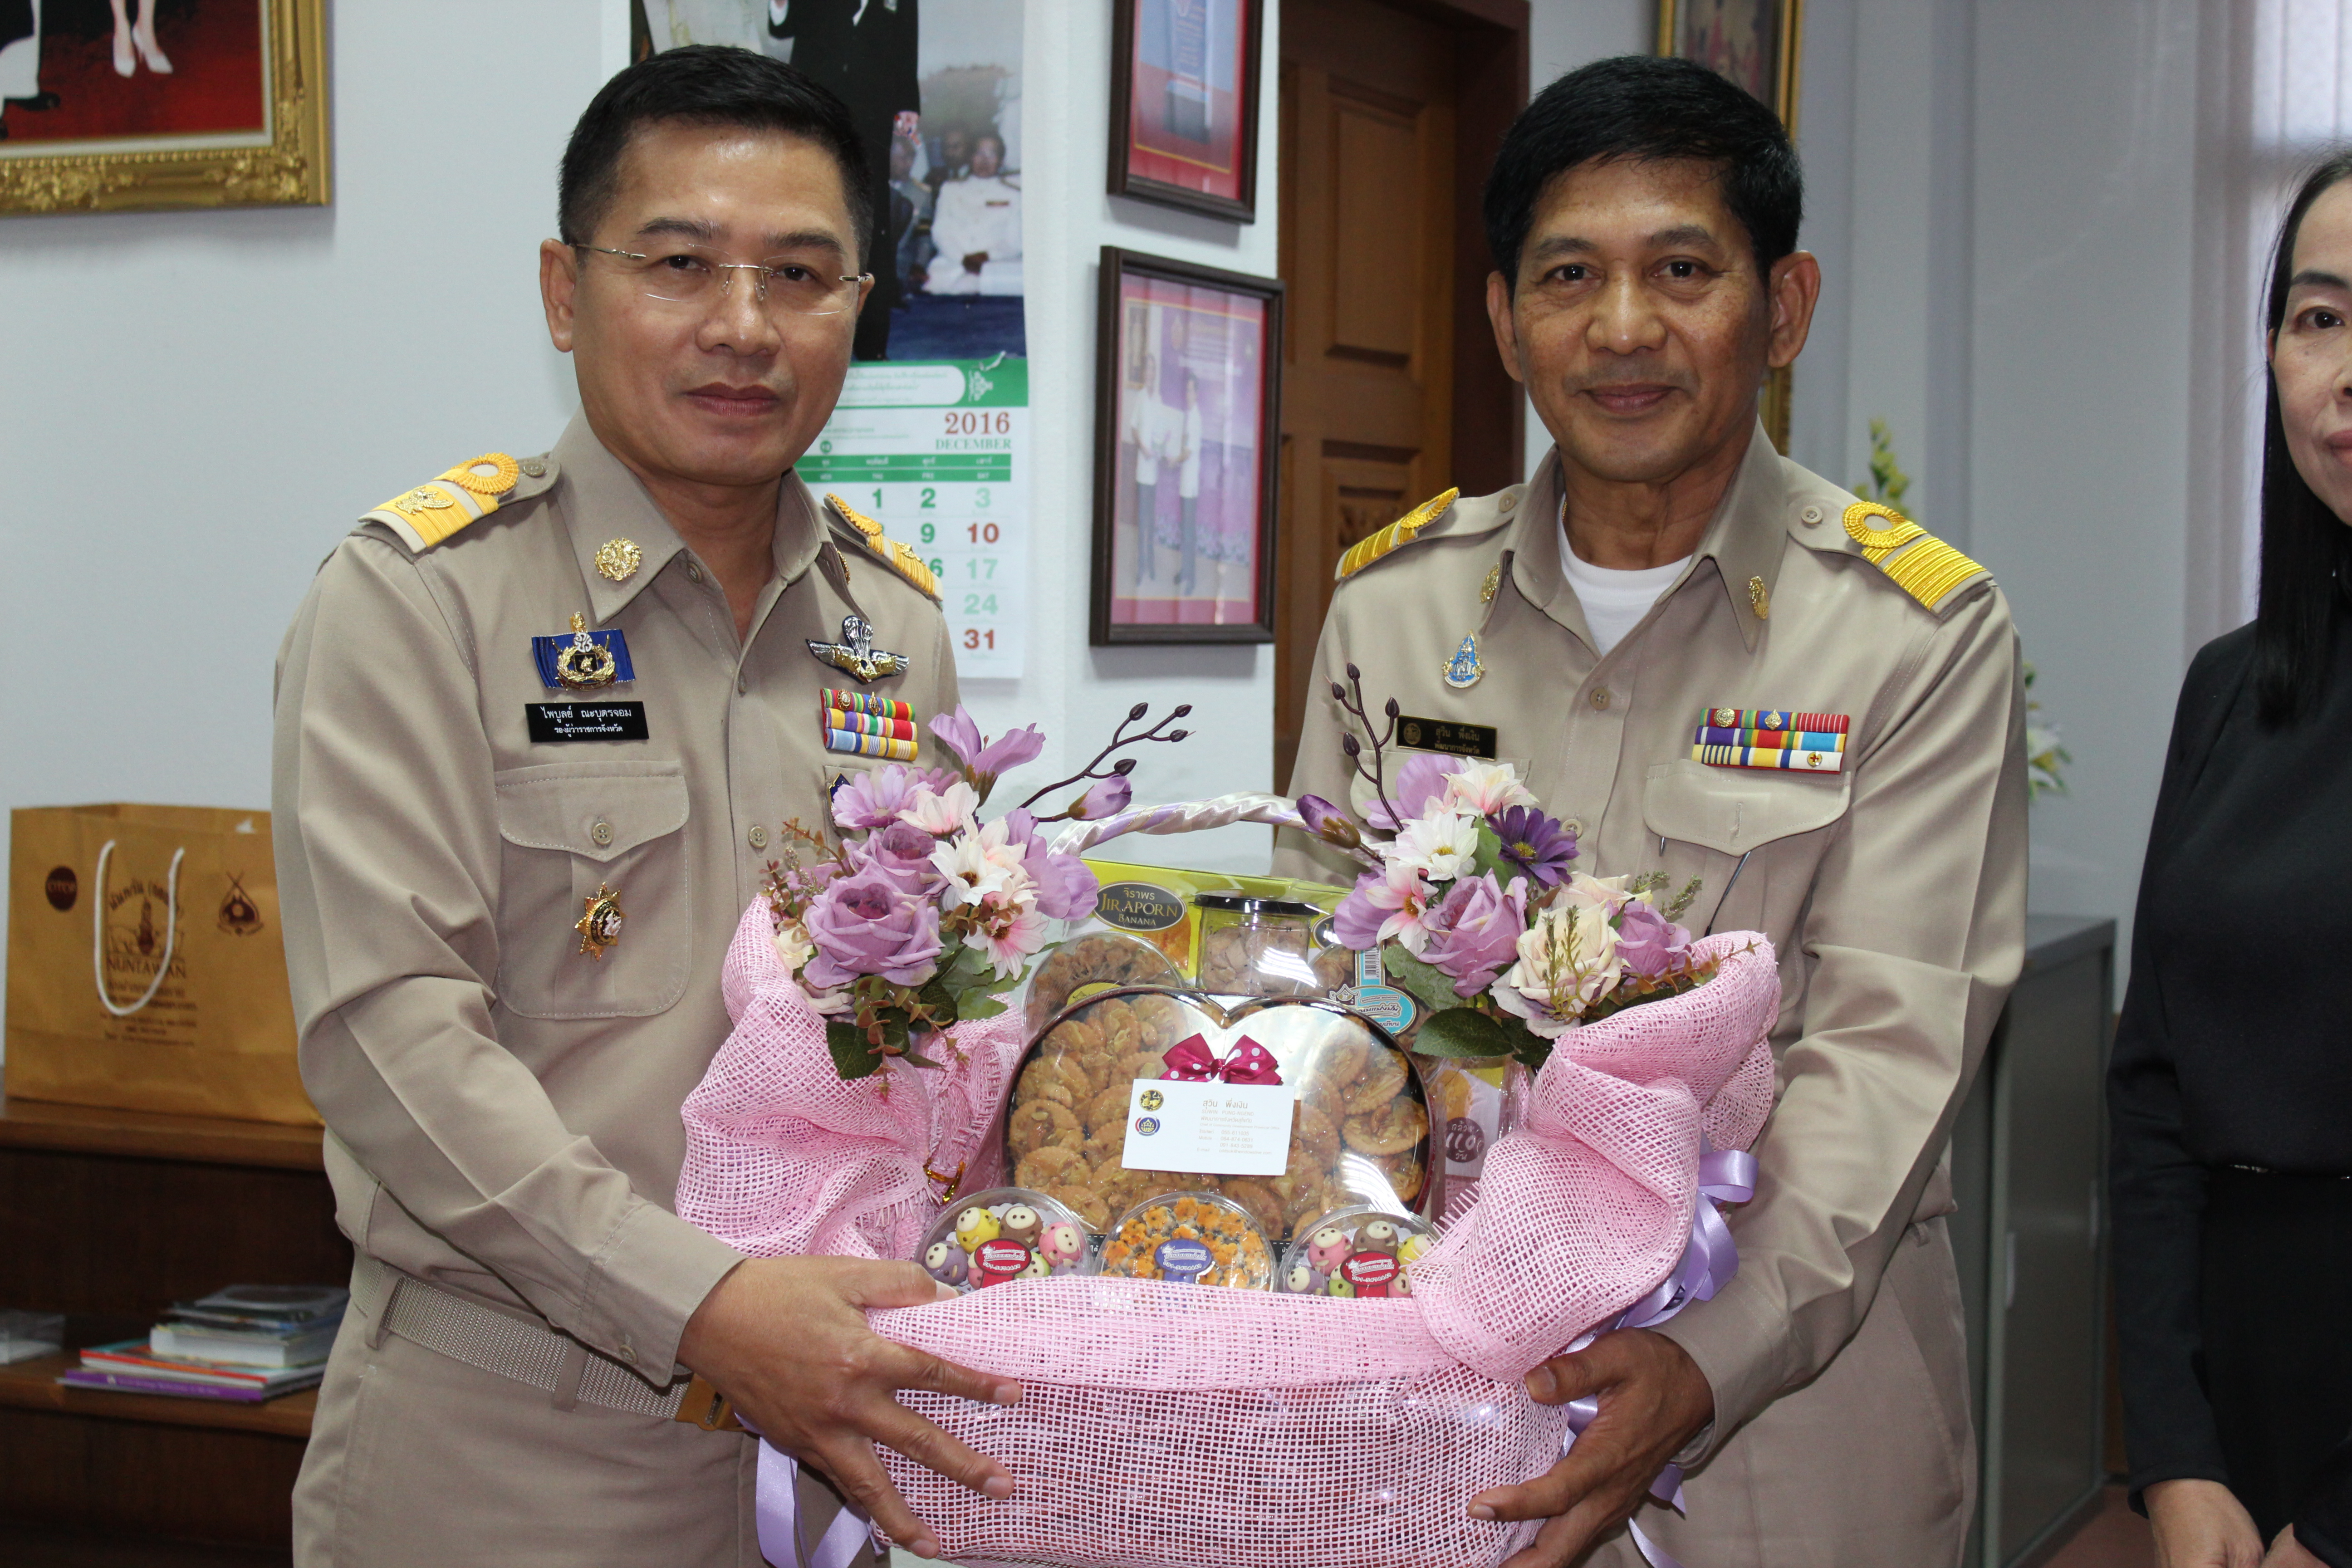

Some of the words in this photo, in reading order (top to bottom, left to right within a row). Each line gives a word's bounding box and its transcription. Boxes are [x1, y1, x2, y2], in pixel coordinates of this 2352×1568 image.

[945, 412, 1010, 434] 2016
[935, 438, 1012, 450] DECEMBER
[872, 488, 882, 508] 1
[921, 488, 936, 508] 2
[975, 488, 991, 508] 3
[921, 523, 935, 543] 9
[967, 523, 1000, 543] 10
[967, 559, 998, 579] 17
[964, 594, 998, 614] 24
[964, 629, 994, 649] 31
[540, 705, 573, 723] ไพบูลย์
[581, 709, 632, 722] ณะบุตรจอม
[554, 723, 623, 737] รองผู้ว่าราชการจังหวัด
[1123, 887, 1155, 901] จิราพร
[1100, 893, 1178, 917] JIRAPORN
[1118, 914, 1156, 926] BANANA
[1202, 1099, 1218, 1109] สุวิน
[1225, 1098, 1248, 1108] พึ่งเงิน
